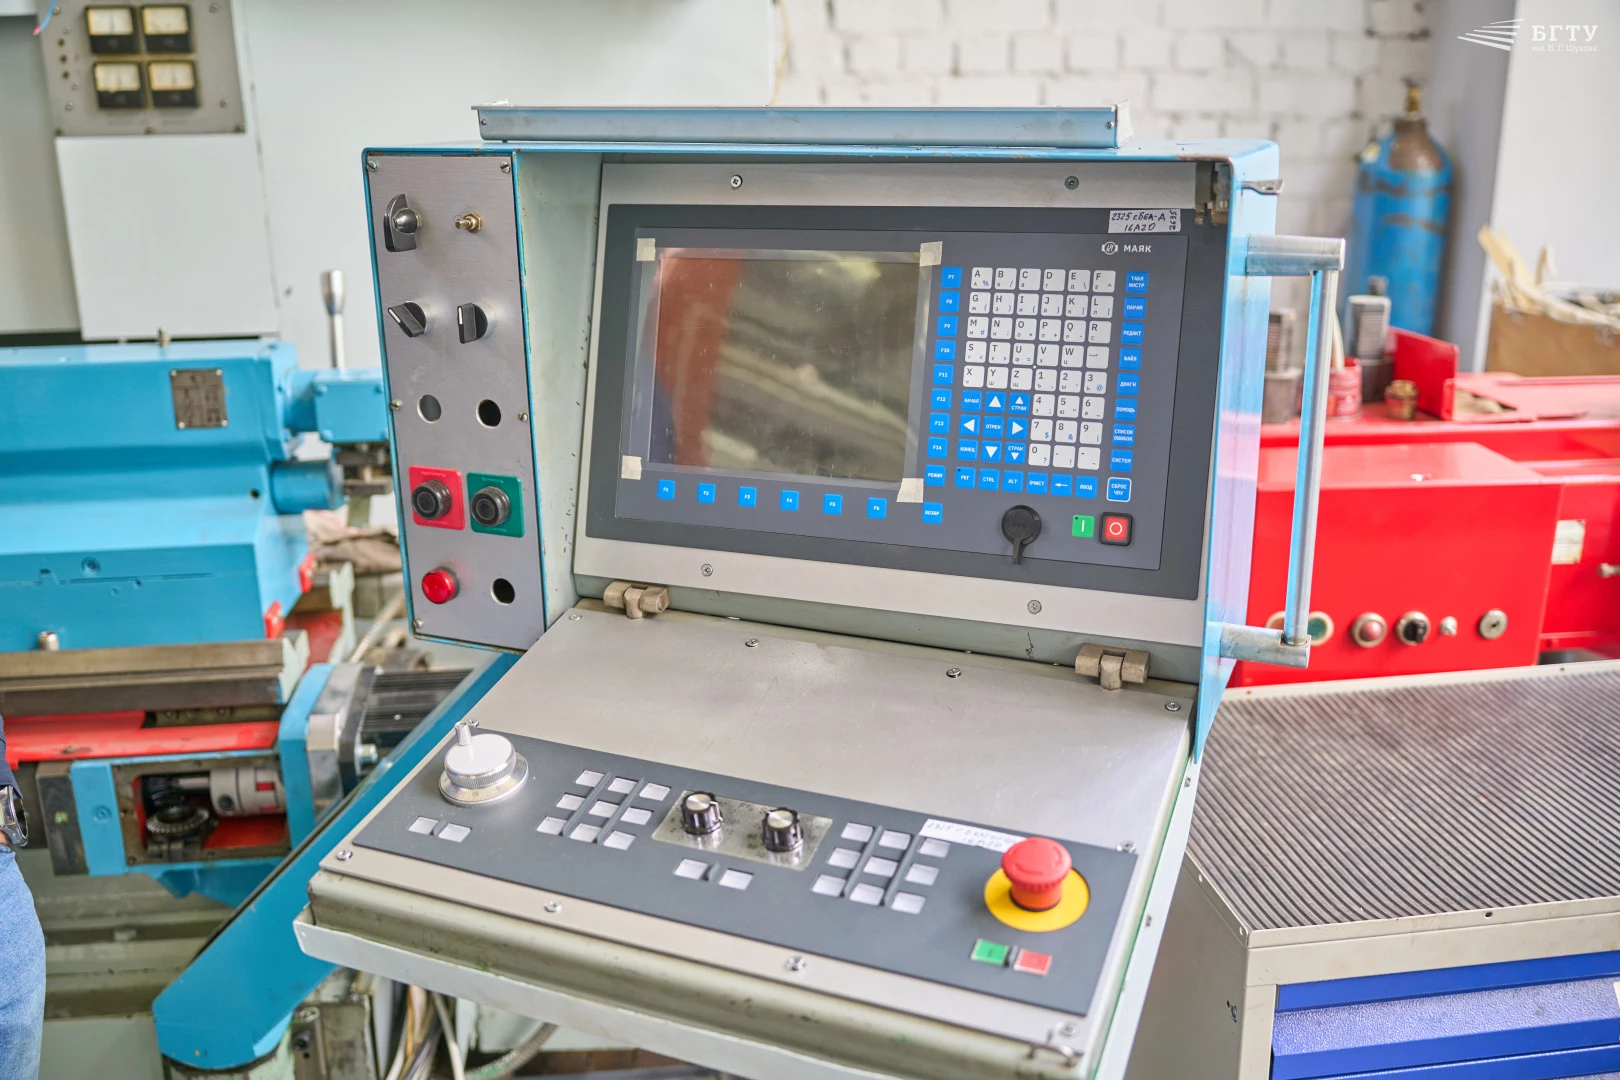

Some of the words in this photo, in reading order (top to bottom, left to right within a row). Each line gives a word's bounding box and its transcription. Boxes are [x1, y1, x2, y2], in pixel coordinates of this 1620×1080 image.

[1123, 244, 1152, 253] МАЯК
[974, 270, 981, 278] A
[998, 270, 1004, 278] B
[1022, 271, 1028, 279] C
[1046, 271, 1053, 279] D
[1071, 272, 1077, 280] E
[972, 294, 979, 302] G
[1044, 297, 1050, 305] J
[1068, 297, 1075, 305] K
[1093, 298, 1099, 306] L
[1067, 323, 1074, 332] Q
[1092, 323, 1098, 331] R
[1065, 348, 1074, 356] W
[1013, 370, 1019, 378] Z
[1062, 373, 1068, 381] 2
[1087, 374, 1093, 382] 3
[1036, 396, 1042, 404] 4
[1034, 421, 1040, 429] 7
[1058, 423, 1064, 431] 8
[1083, 424, 1089, 432] 9
